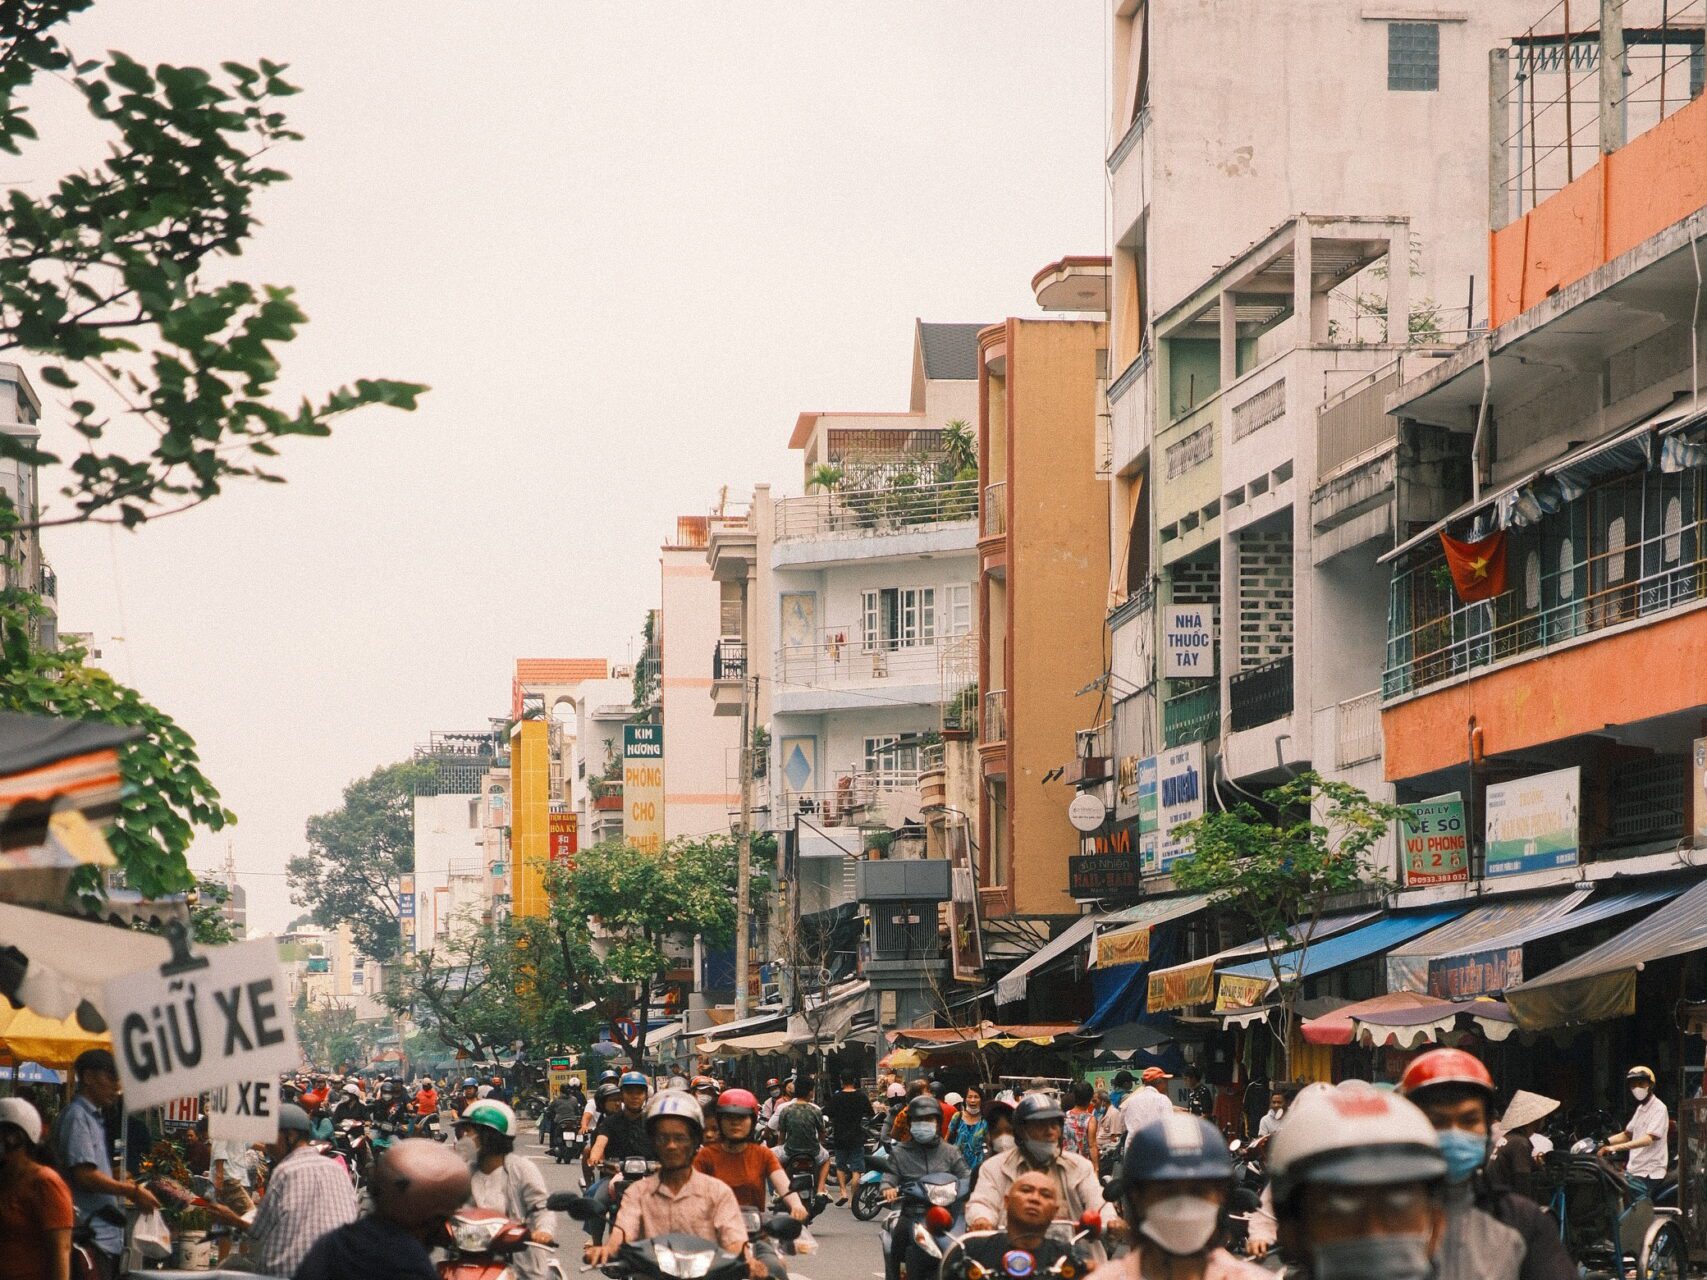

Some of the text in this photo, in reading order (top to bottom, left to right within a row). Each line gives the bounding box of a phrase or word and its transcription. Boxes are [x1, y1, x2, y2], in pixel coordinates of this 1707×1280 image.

[1175, 611, 1202, 628] NHÀ
[1167, 629, 1209, 647] THUỐC
[1175, 650, 1199, 666] TÂY
[634, 728, 653, 740] KIM
[627, 743, 660, 756] HƯƠNG
[632, 802, 656, 821] CHO
[1437, 813, 1461, 832] SỐ
[1427, 835, 1466, 852] PHONG
[1431, 853, 1442, 867] 2
[213, 978, 285, 1057] XE
[236, 1081, 270, 1117] XE
